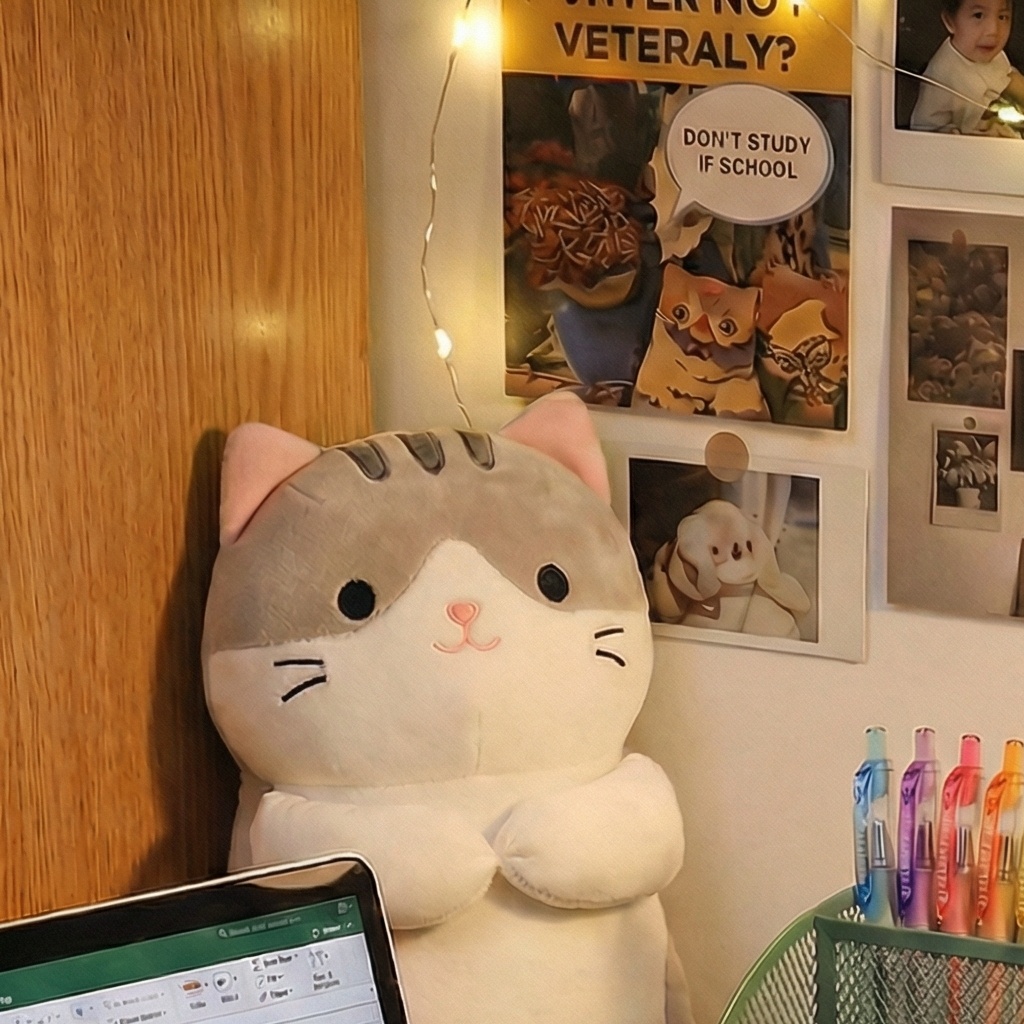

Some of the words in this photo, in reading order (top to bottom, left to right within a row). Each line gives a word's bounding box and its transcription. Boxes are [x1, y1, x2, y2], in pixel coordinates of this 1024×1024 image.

[554, 22, 797, 72] VETERALY?
[683, 128, 742, 149] DON'T
[748, 133, 811, 155] STUDY
[699, 154, 714, 173] IF
[719, 157, 798, 179] SCHOOL
